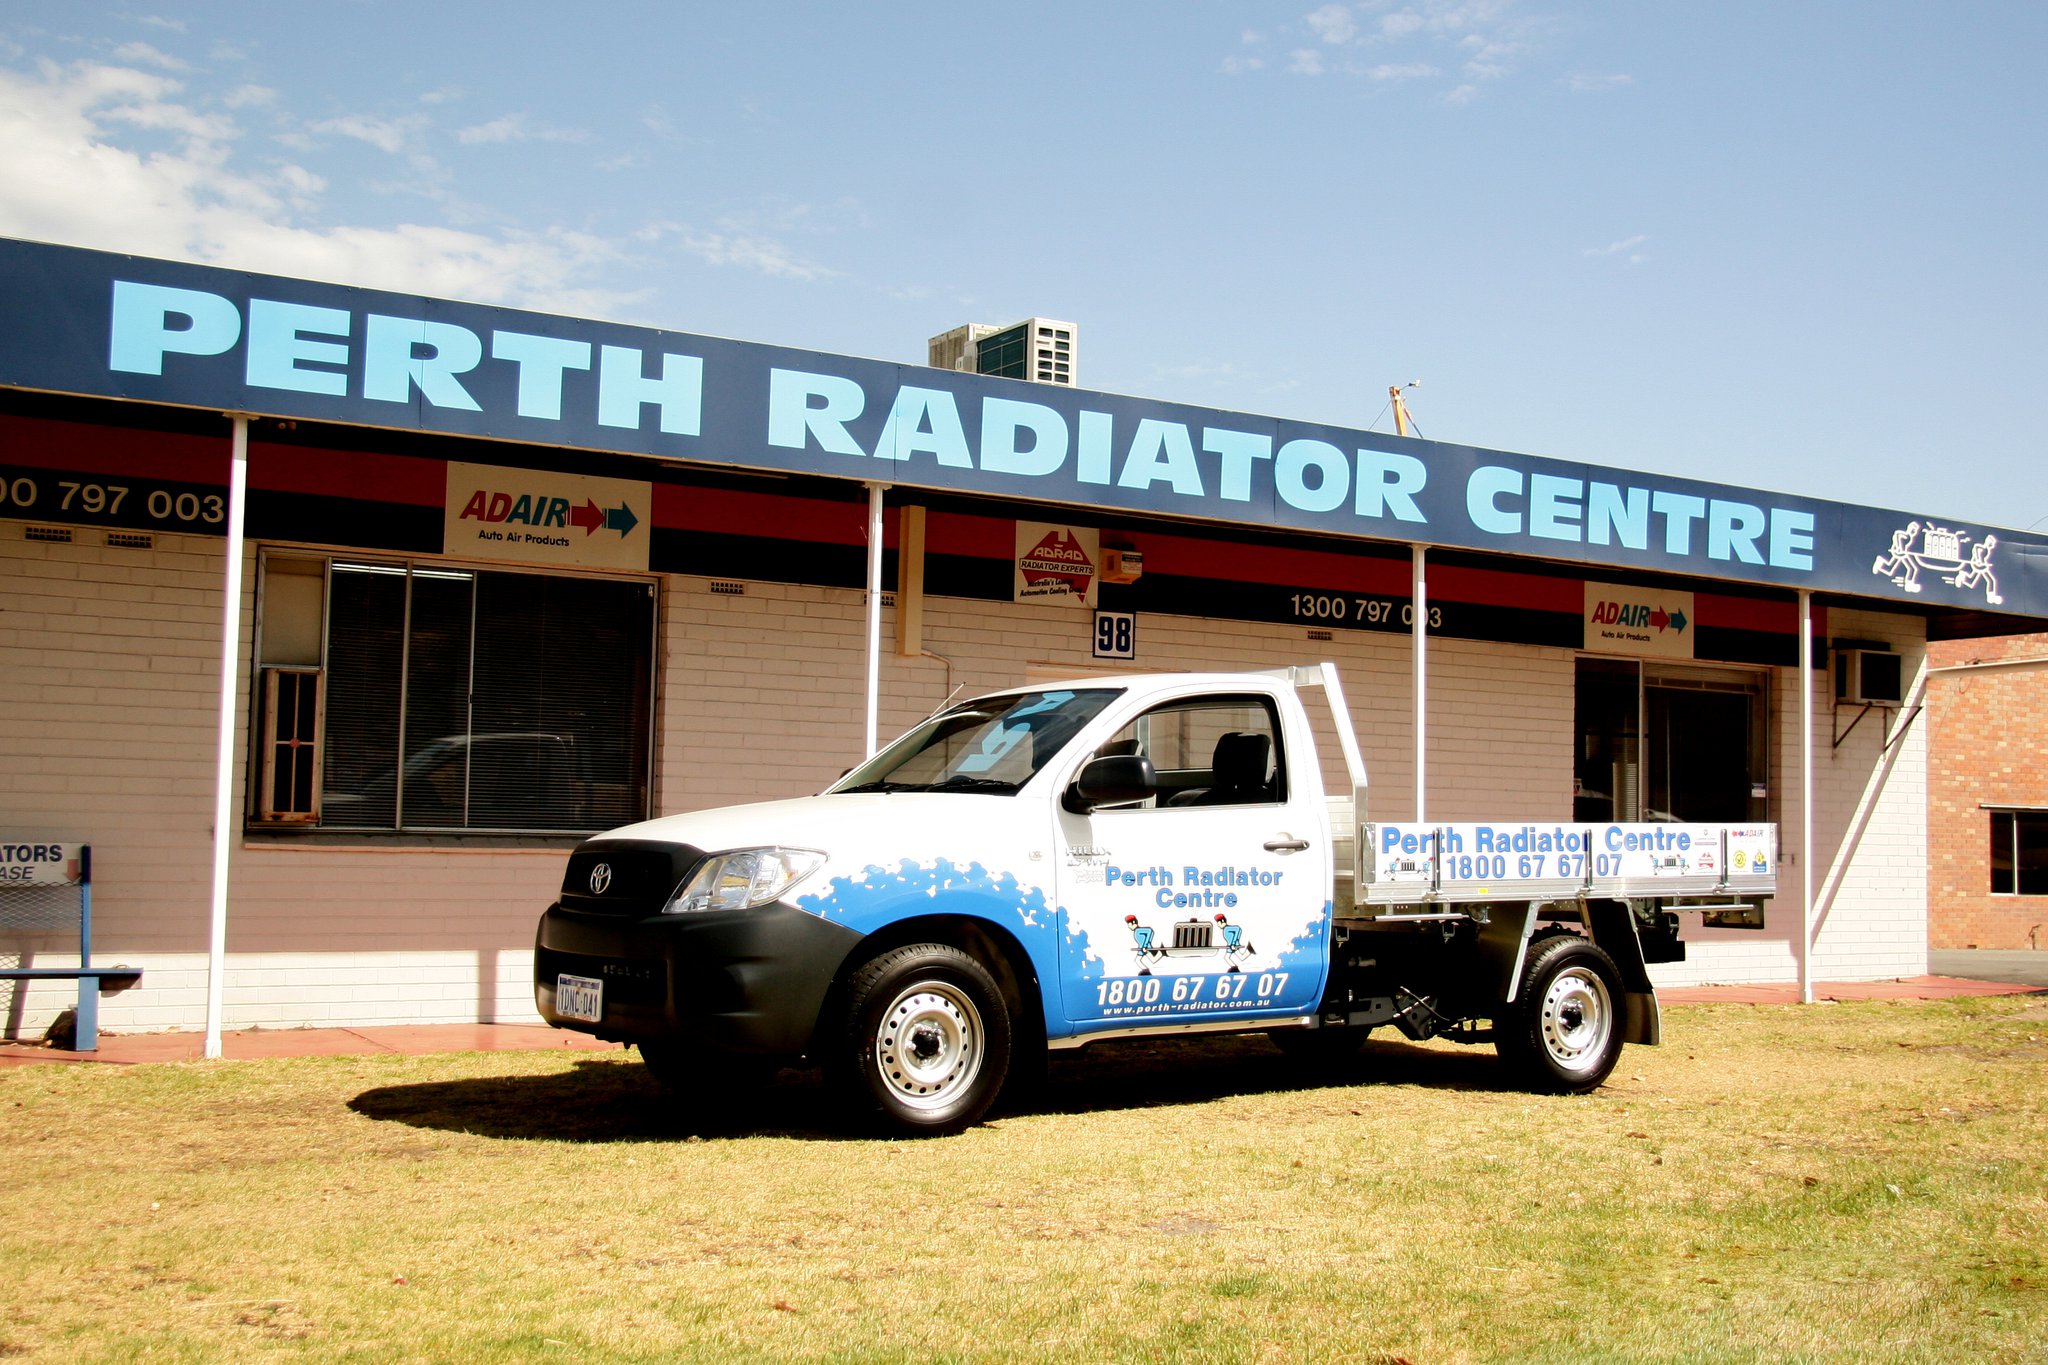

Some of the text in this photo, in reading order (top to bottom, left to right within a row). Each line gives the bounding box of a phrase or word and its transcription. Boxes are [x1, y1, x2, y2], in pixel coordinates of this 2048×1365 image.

[110, 279, 1815, 571] PERTH RADIATOR CENTRE
[58, 481, 129, 515] 797
[148, 490, 225, 523] 003
[459, 490, 570, 528] ADAIR
[479, 529, 570, 547] Auto Air Products
[1034, 546, 1084, 561] ADRAD
[1021, 560, 1094, 575] RADIATOR EXPERTS
[1291, 594, 1442, 628] 1300 797 03
[1591, 601, 1650, 628] ADAIR
[1098, 616, 1131, 652] 98
[1601, 630, 1651, 642] Auto Air Products
[1604, 826, 1691, 852] Centre
[0, 844, 63, 862] TORS
[1105, 865, 1173, 887] Perth
[1183, 865, 1283, 886] Radiator
[1446, 854, 1622, 880] 1800 67 67 07
[1156, 888, 1238, 909] Centre
[1096, 972, 1289, 1006] 1800 67 67 07
[1103, 999, 1271, 1016] www.perth-radiator.com.au
